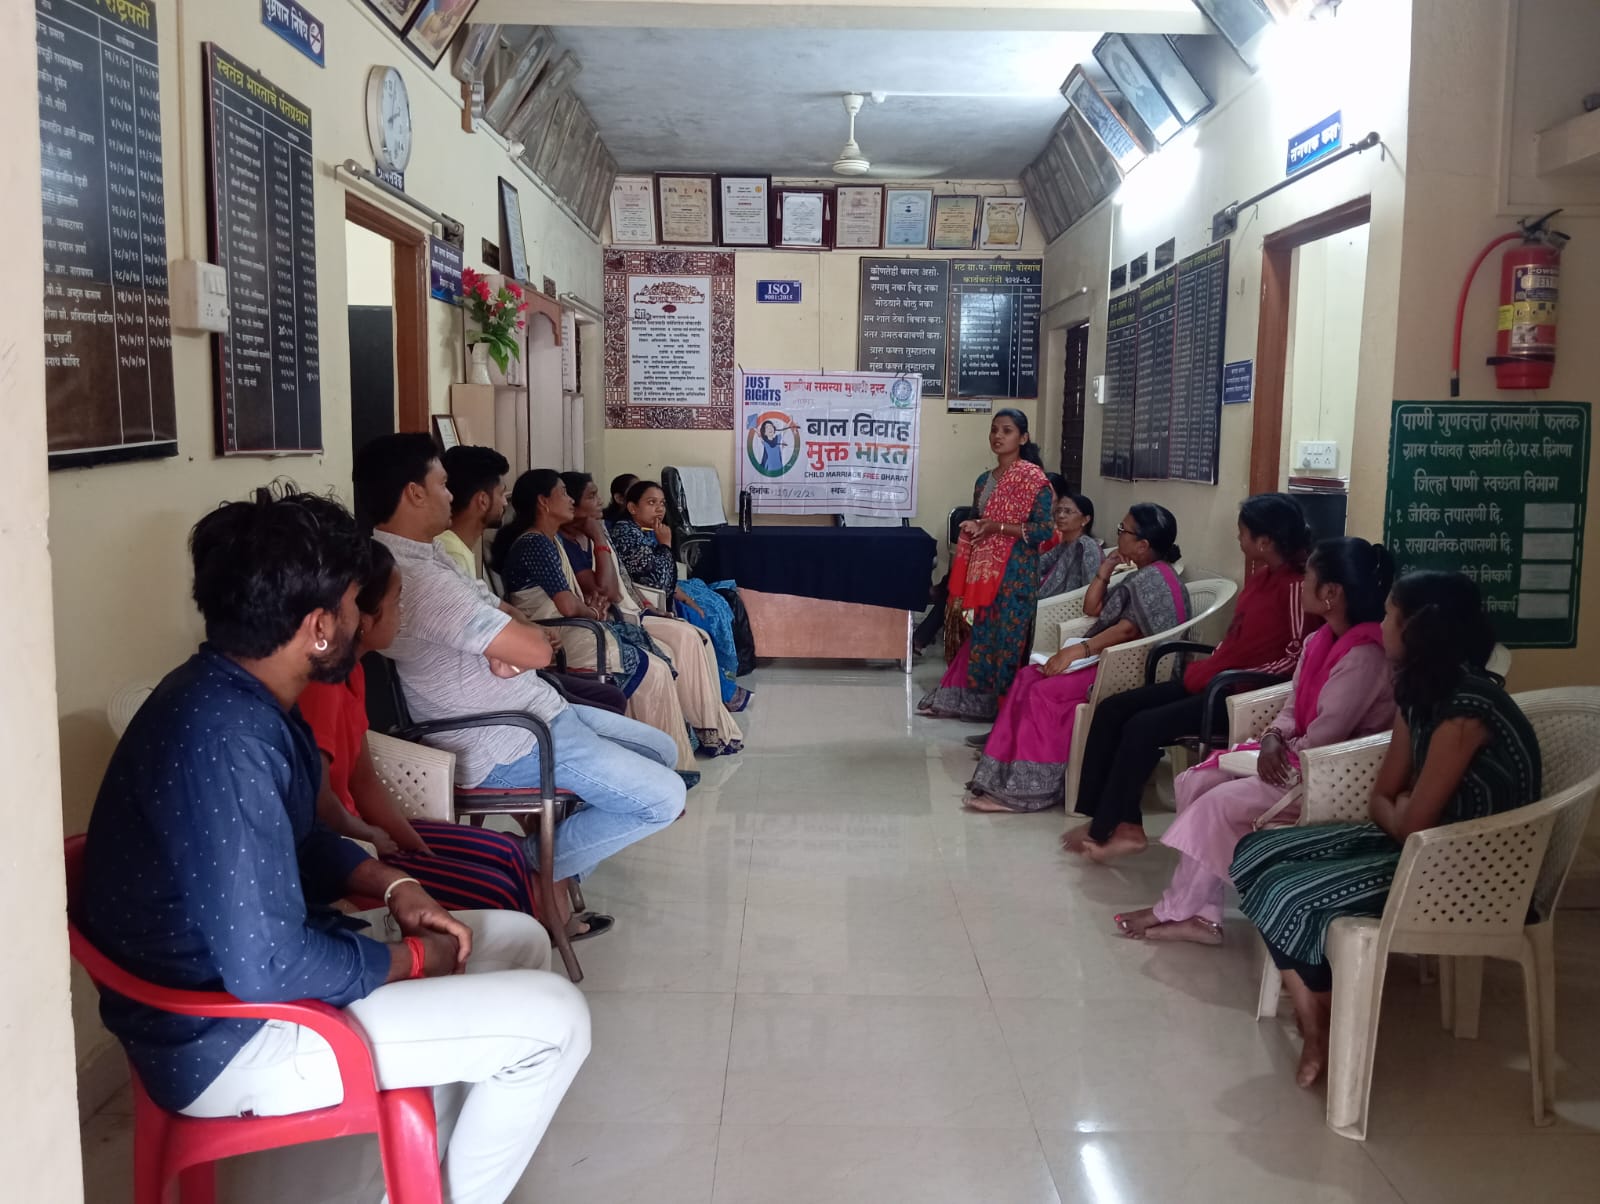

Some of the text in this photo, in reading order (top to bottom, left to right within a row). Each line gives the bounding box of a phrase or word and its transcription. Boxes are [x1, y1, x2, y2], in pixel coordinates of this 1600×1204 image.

[768, 283, 790, 294] ISO
[745, 376, 770, 388] JUST
[814, 381, 842, 392] समस्या
[745, 389, 781, 401] RIGHTS
[806, 412, 911, 441] बाल विवाह
[1402, 407, 1434, 431] पाणी
[1490, 407, 1540, 432] तपासणी
[1543, 413, 1580, 434] फलक
[805, 440, 910, 471] मुक्त भारत
[1403, 444, 1428, 461] ग्राम
[1430, 440, 1464, 460] पंचायत
[1468, 439, 1501, 460] सावंगी
[881, 474, 908, 482] BHARAT
[1413, 468, 1449, 496] जिल्हा
[1450, 470, 1480, 492] पाणी
[1408, 502, 1441, 523] जैविक
[1444, 503, 1487, 526] तपासणी
[1405, 530, 1459, 554] रासायनिक
[1460, 532, 1499, 555] तपासणी
